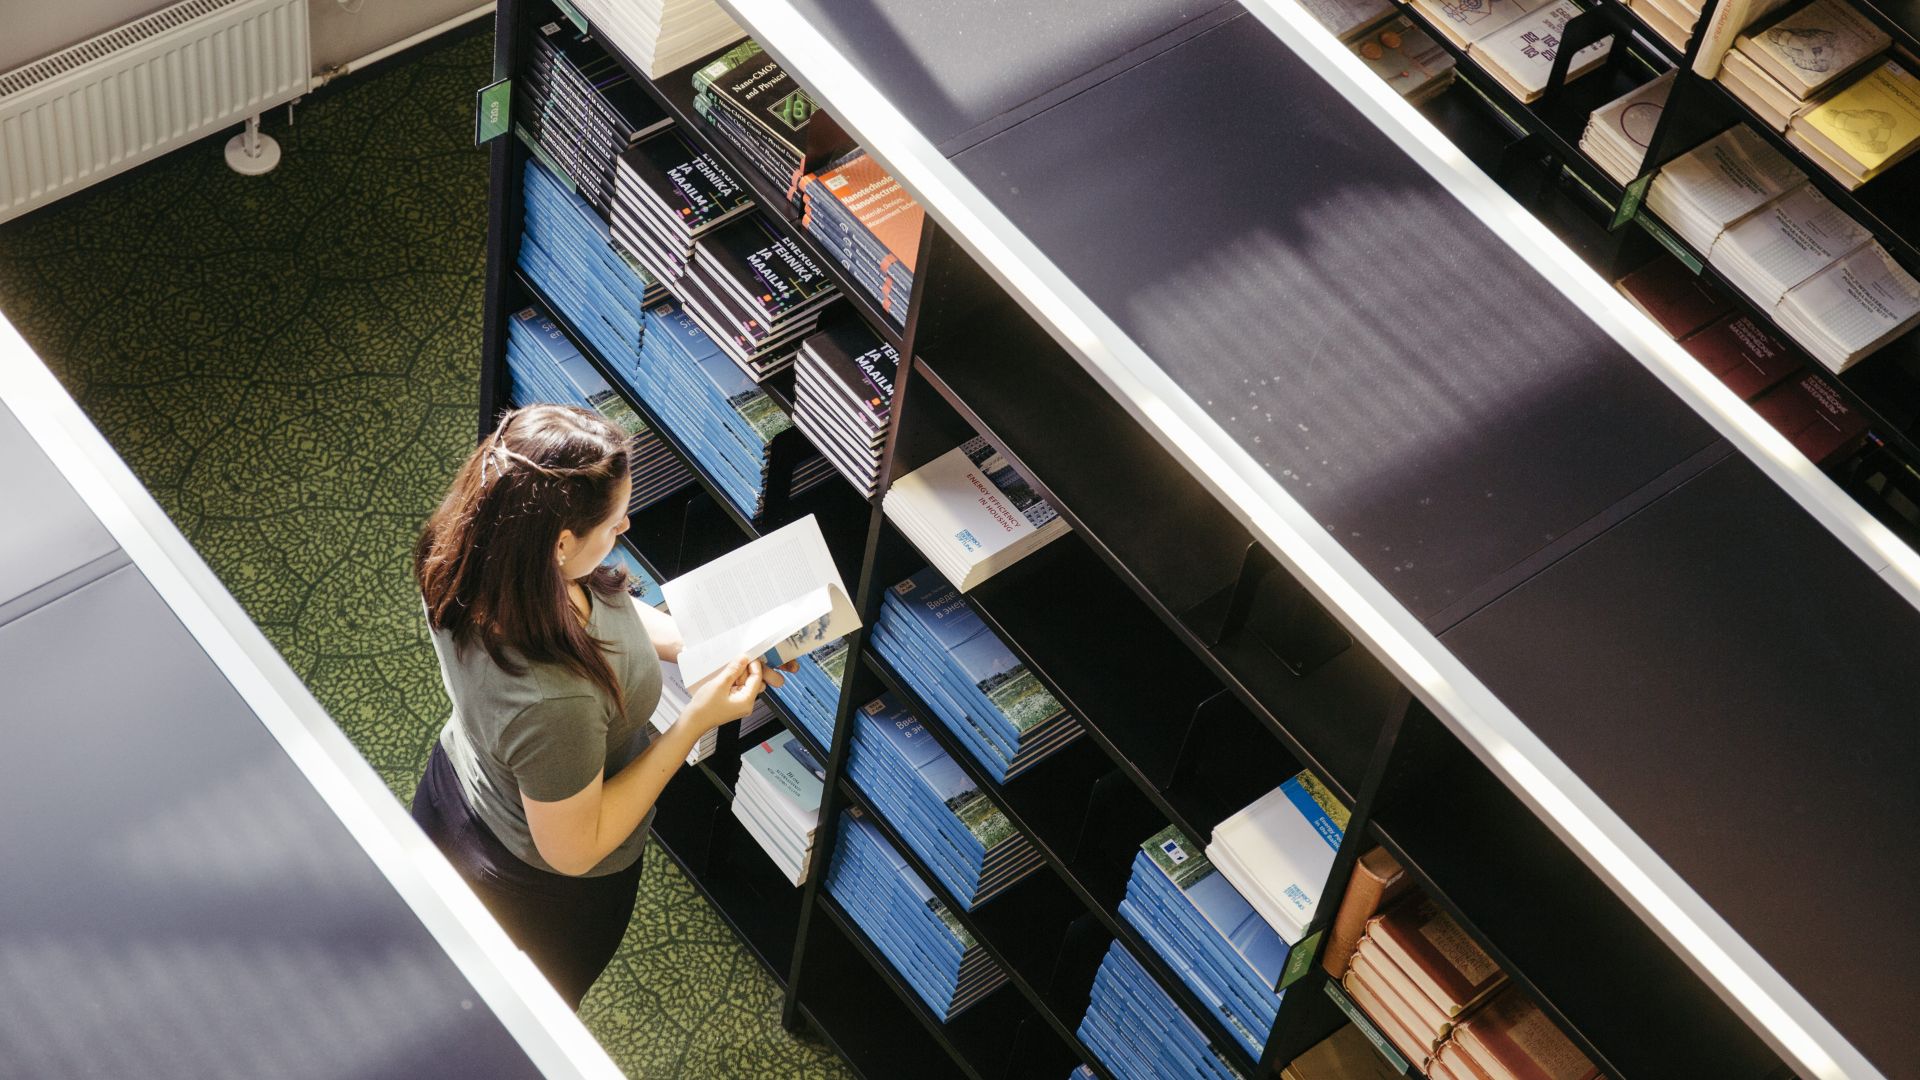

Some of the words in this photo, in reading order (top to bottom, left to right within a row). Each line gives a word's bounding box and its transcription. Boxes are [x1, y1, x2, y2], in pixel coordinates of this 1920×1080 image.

[732, 62, 778, 93] Nano-CMOS
[745, 90, 760, 100] and
[757, 71, 788, 92] Physical
[676, 163, 693, 174] JA
[692, 156, 732, 197] TEHNIKA
[667, 168, 708, 206] MAAILM
[756, 248, 772, 260] JA
[771, 242, 812, 282] TEHNIKA
[782, 236, 824, 278] ENERGIA-
[746, 254, 788, 292] MAAILM
[864, 349, 882, 362] JA
[880, 342, 900, 366] TEH
[855, 356, 894, 396] MAAILM
[966, 473, 990, 496] ENERGY
[988, 495, 1021, 528] EFFICIENCY
[978, 497, 988, 506] IN
[986, 505, 1014, 532] HOUSING
[1320, 816, 1334, 834] Energy
[1320, 826, 1328, 836] the
